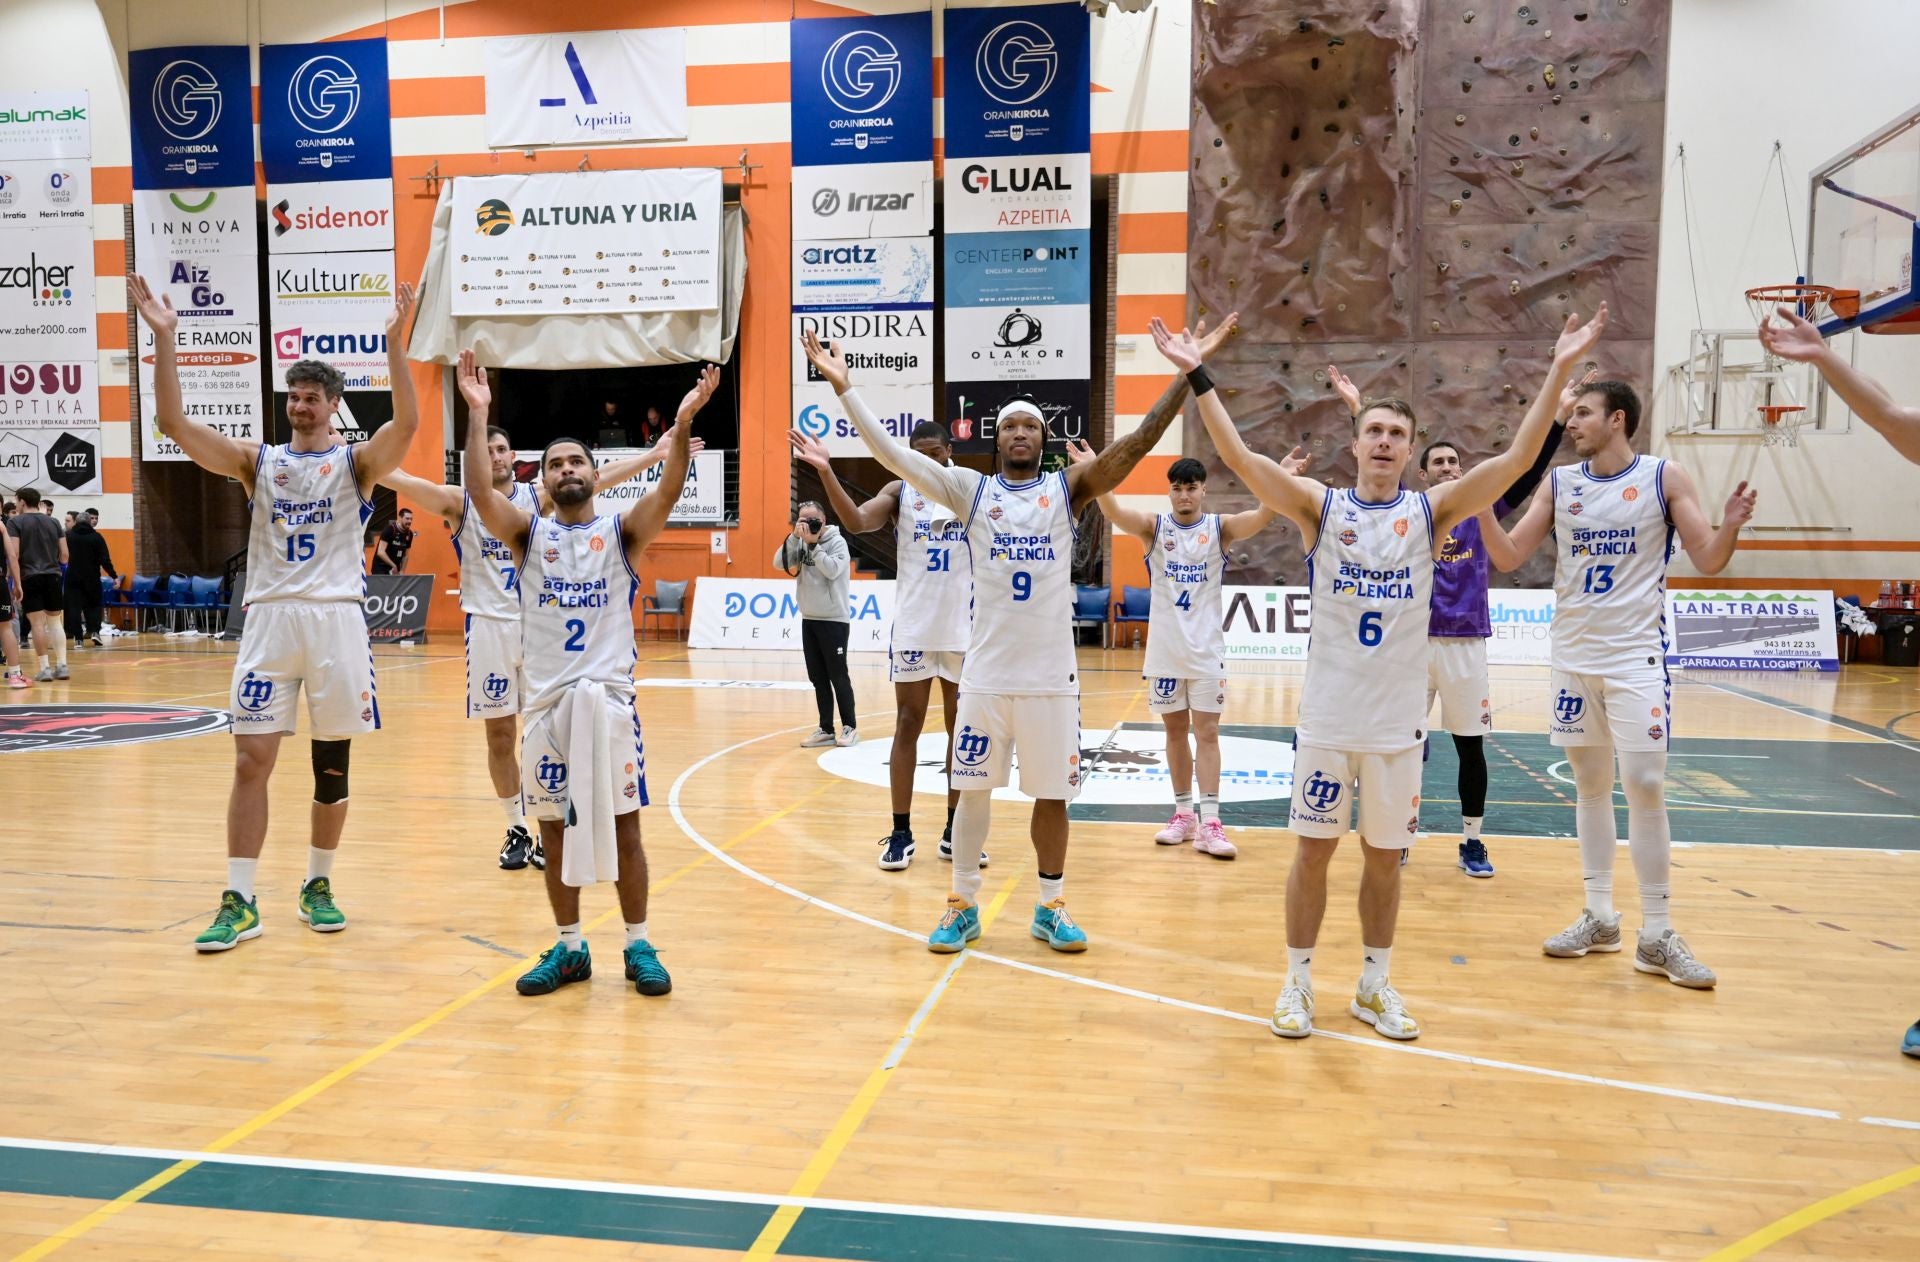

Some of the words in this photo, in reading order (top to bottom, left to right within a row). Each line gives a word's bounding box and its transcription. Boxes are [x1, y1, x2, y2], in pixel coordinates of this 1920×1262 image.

[984, 109, 1050, 120] ORAINKIROLA
[829, 118, 893, 129] ORAINKIROLA
[162, 144, 218, 155] ORAINKIROLA
[295, 138, 355, 148] ORAINKIROLA
[962, 164, 1071, 194] GLUAL
[40, 210, 58, 219] Herri
[61, 208, 85, 218] Irratia
[296, 206, 389, 230] sidenor
[521, 206, 616, 227] ALTUNA
[622, 204, 638, 223] Y
[642, 202, 697, 222] URIA
[998, 209, 1071, 225] AZPEITIA
[152, 220, 240, 235] INNOVA
[803, 244, 876, 265] aratz
[0, 252, 74, 299] zaher
[170, 262, 209, 283] Aiz
[192, 286, 224, 308] Go
[800, 314, 927, 338] DISDIRA
[146, 332, 187, 346] JE
[192, 331, 252, 345] RAMON
[177, 354, 233, 364] arategia
[845, 352, 918, 372] Bitxitegia
[972, 350, 1064, 360] OLAKOR
[211, 369, 241, 379] Azpeitia
[205, 381, 218, 389] 636
[184, 404, 251, 416] JATETXEA
[55, 454, 87, 468] LATZ
[915, 520, 963, 531] agpal
[993, 534, 1051, 547] agropal
[1573, 527, 1635, 542] agropal
[287, 534, 316, 561] 15
[927, 548, 949, 572] 31
[1167, 562, 1207, 572] agropal
[501, 567, 516, 590] 7
[1339, 566, 1410, 582] agropal
[1583, 565, 1616, 594] 13
[543, 578, 606, 593] agropal
[1012, 571, 1031, 601] 9
[1175, 590, 1191, 611] 4
[364, 595, 418, 623] oup
[1673, 602, 1799, 615] LAN-TRANS
[564, 619, 586, 651] 2
[1358, 612, 1382, 646] 6
[1281, 643, 1302, 655] eta
[1764, 640, 1779, 648] 943
[1781, 640, 1790, 648] 81
[1793, 640, 1803, 648] 22
[1806, 640, 1816, 648] 33
[1753, 649, 1821, 657] www.lantrans.es
[1680, 657, 1737, 668] GARRAIOA
[1740, 659, 1760, 668] ETA
[1763, 659, 1822, 670] LOGISTIKA
